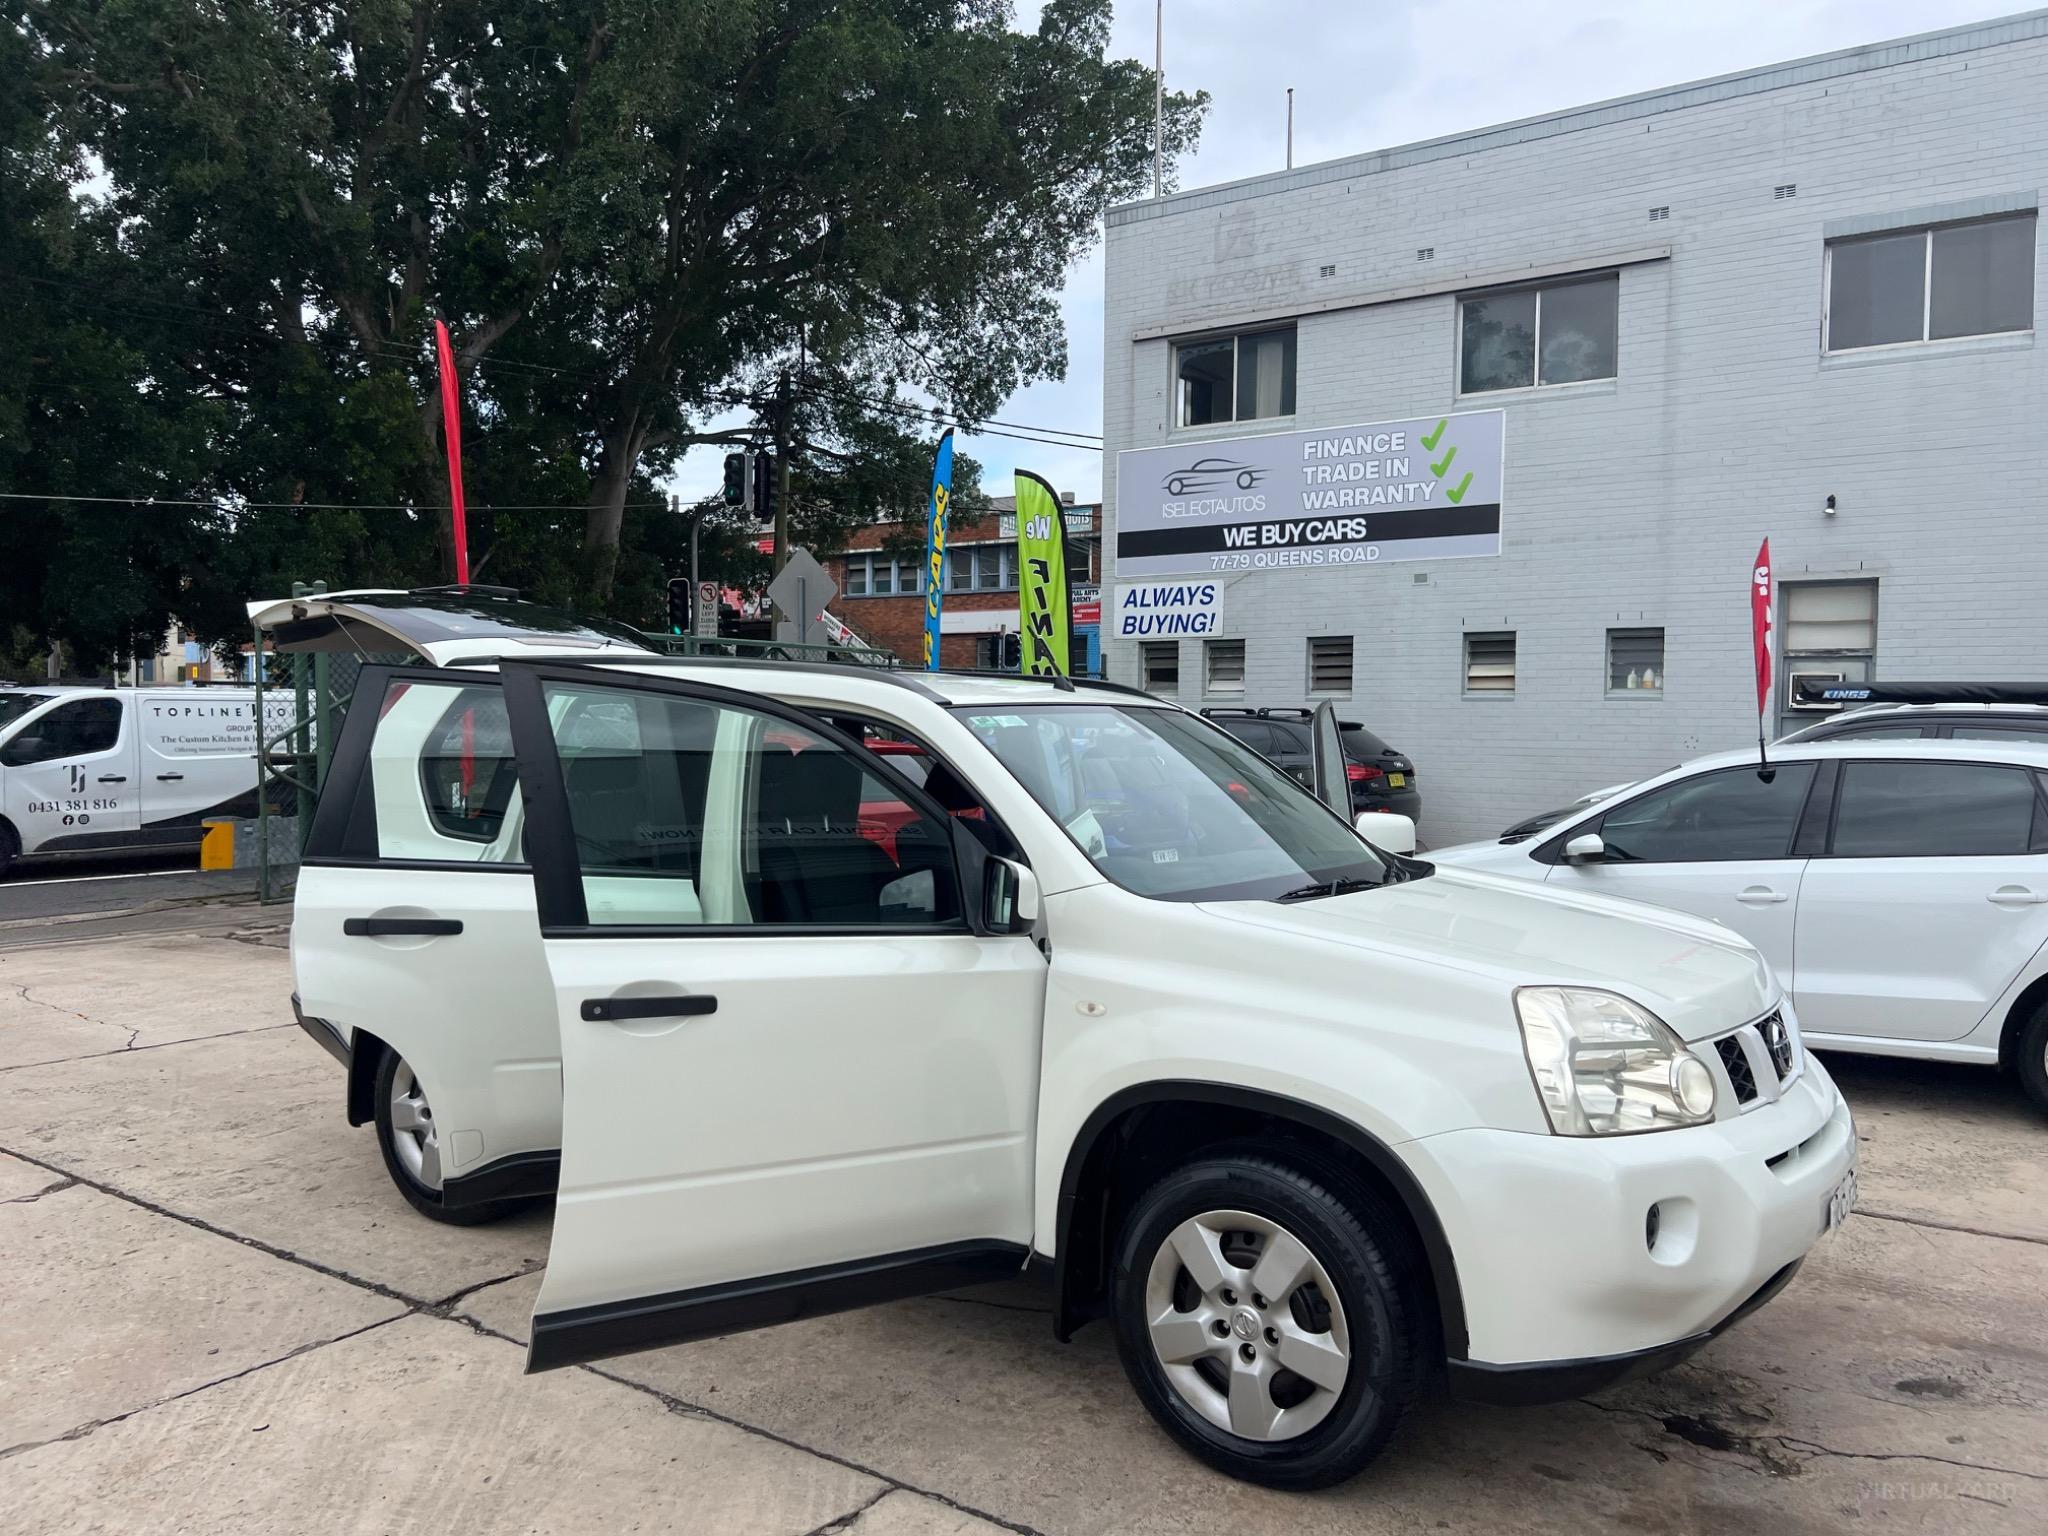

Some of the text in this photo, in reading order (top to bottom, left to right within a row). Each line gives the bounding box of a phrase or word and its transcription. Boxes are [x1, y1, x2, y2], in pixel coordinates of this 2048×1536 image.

[1303, 431, 1406, 461] FINANCE
[1303, 456, 1410, 486] TRADE IN
[1302, 480, 1438, 511] WARRANTY
[1223, 517, 1367, 548] WE BUY CARS
[1210, 545, 1380, 571] 77-79 QUEENS ROAD
[1123, 584, 1216, 609] ALWAYS
[1121, 612, 1216, 635] BUYING!
[1822, 690, 1871, 700] KINGS
[153, 707, 242, 717] TOPLINE
[161, 736, 177, 744] The
[178, 735, 210, 744] Custom
[212, 735, 242, 743] Kitchen
[28, 798, 117, 813] 0431 381 816
